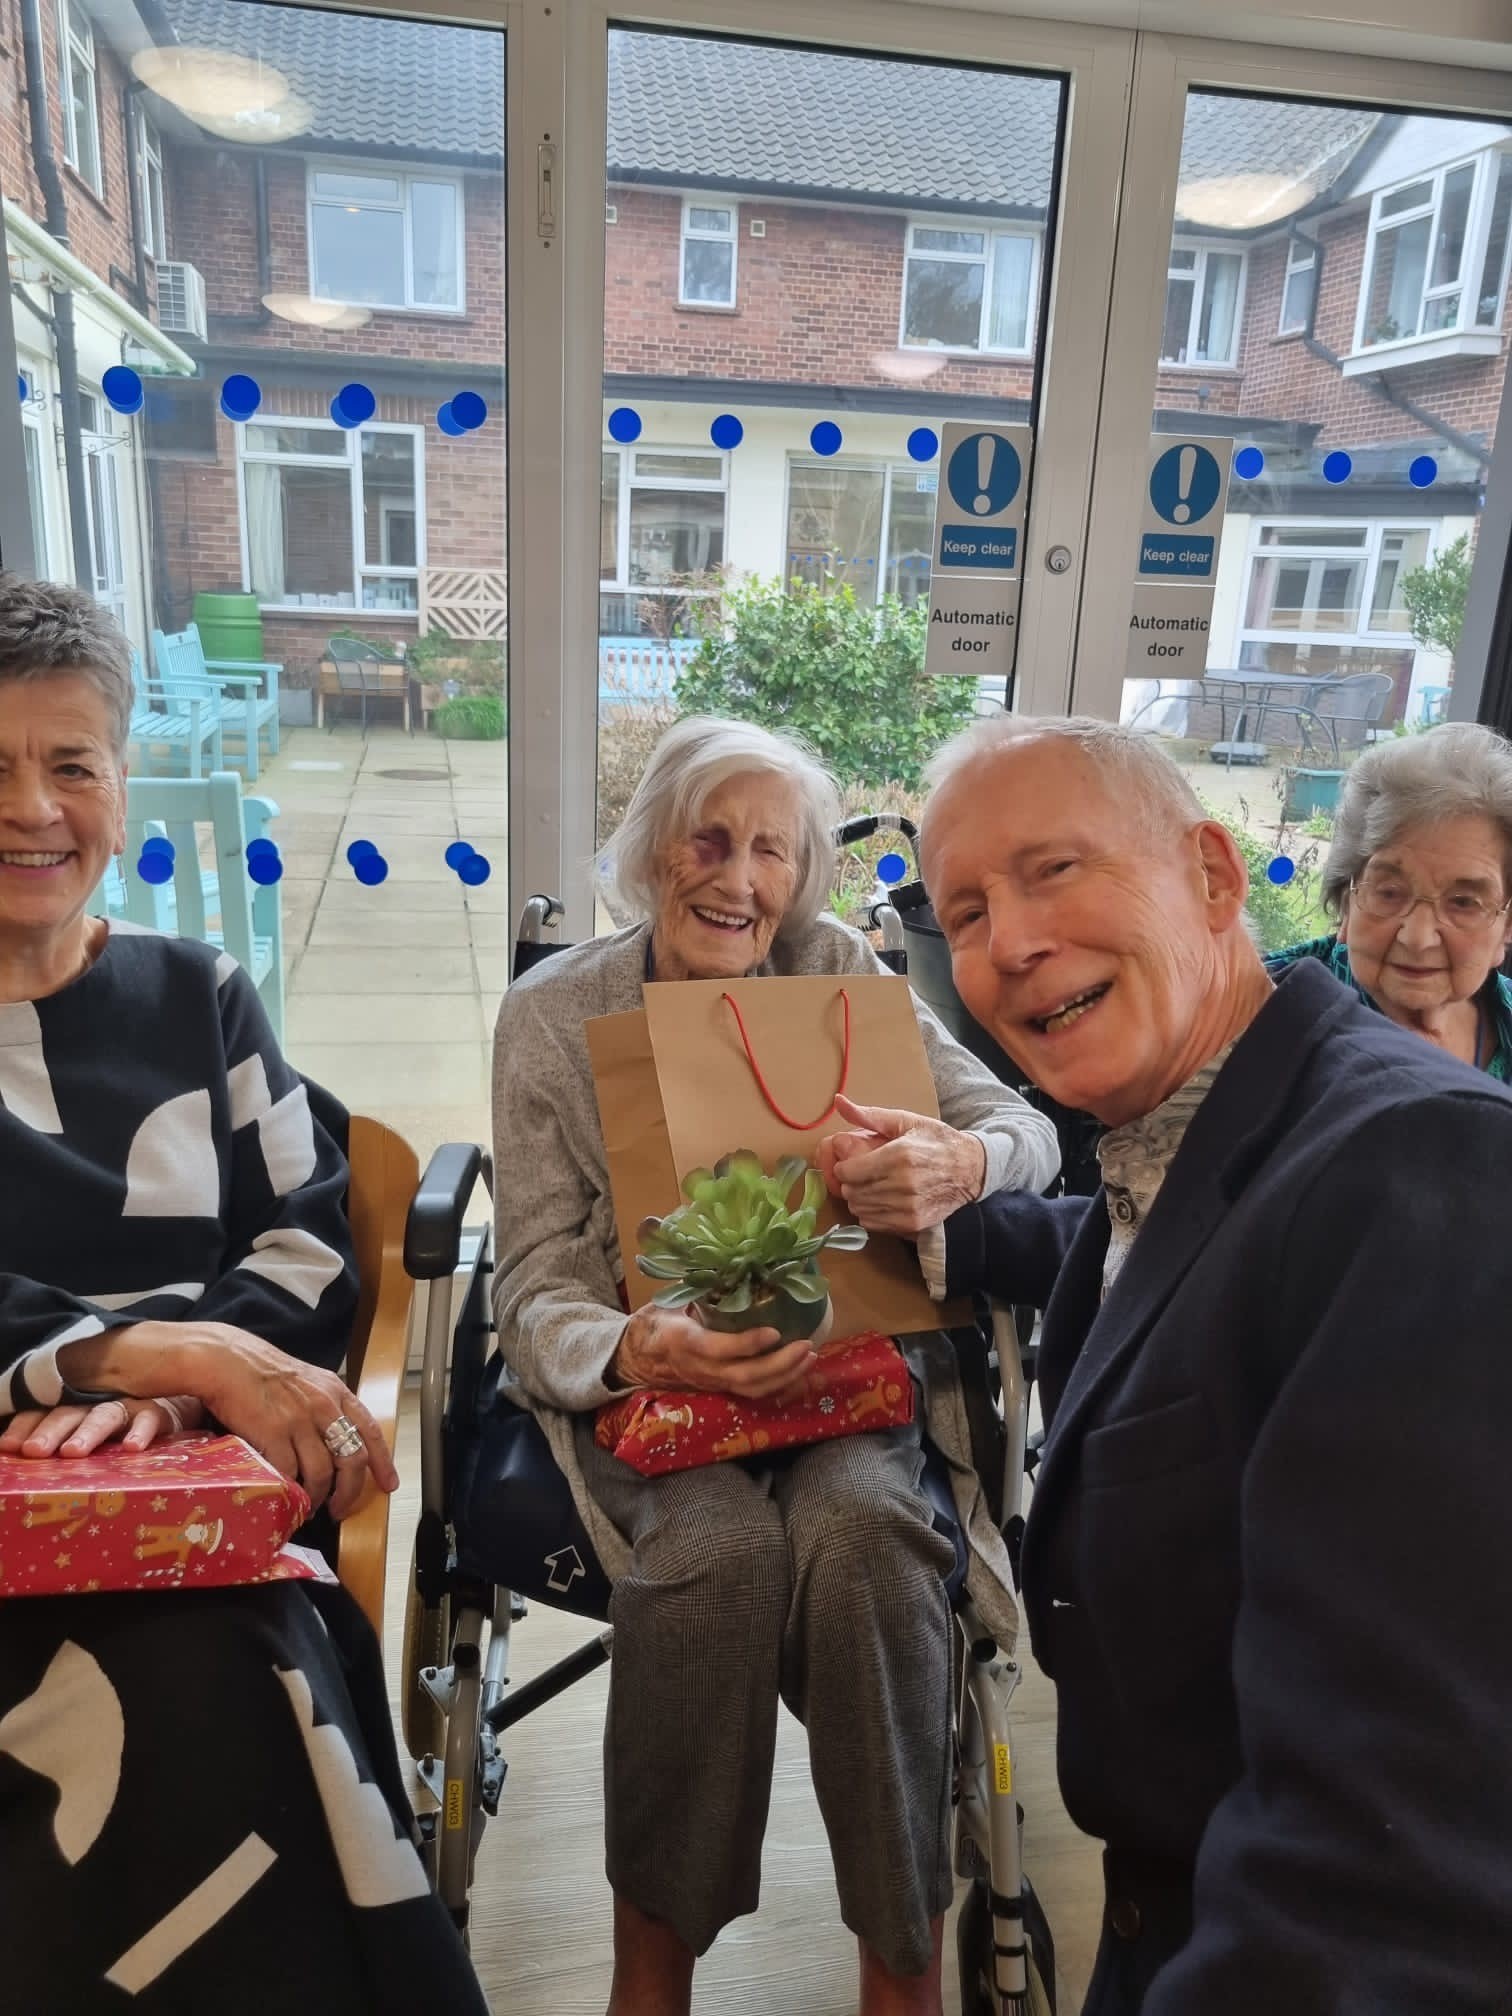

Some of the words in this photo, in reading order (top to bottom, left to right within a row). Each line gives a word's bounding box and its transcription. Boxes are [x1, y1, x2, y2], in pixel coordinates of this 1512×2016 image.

[944, 541, 976, 556] Keep
[981, 543, 1013, 555] clear
[1143, 548, 1175, 564] Keep
[1179, 550, 1210, 563] clear
[931, 609, 1015, 626] Automatic
[1129, 615, 1209, 631] Automatic
[951, 637, 990, 652] door
[1147, 642, 1184, 657] door
